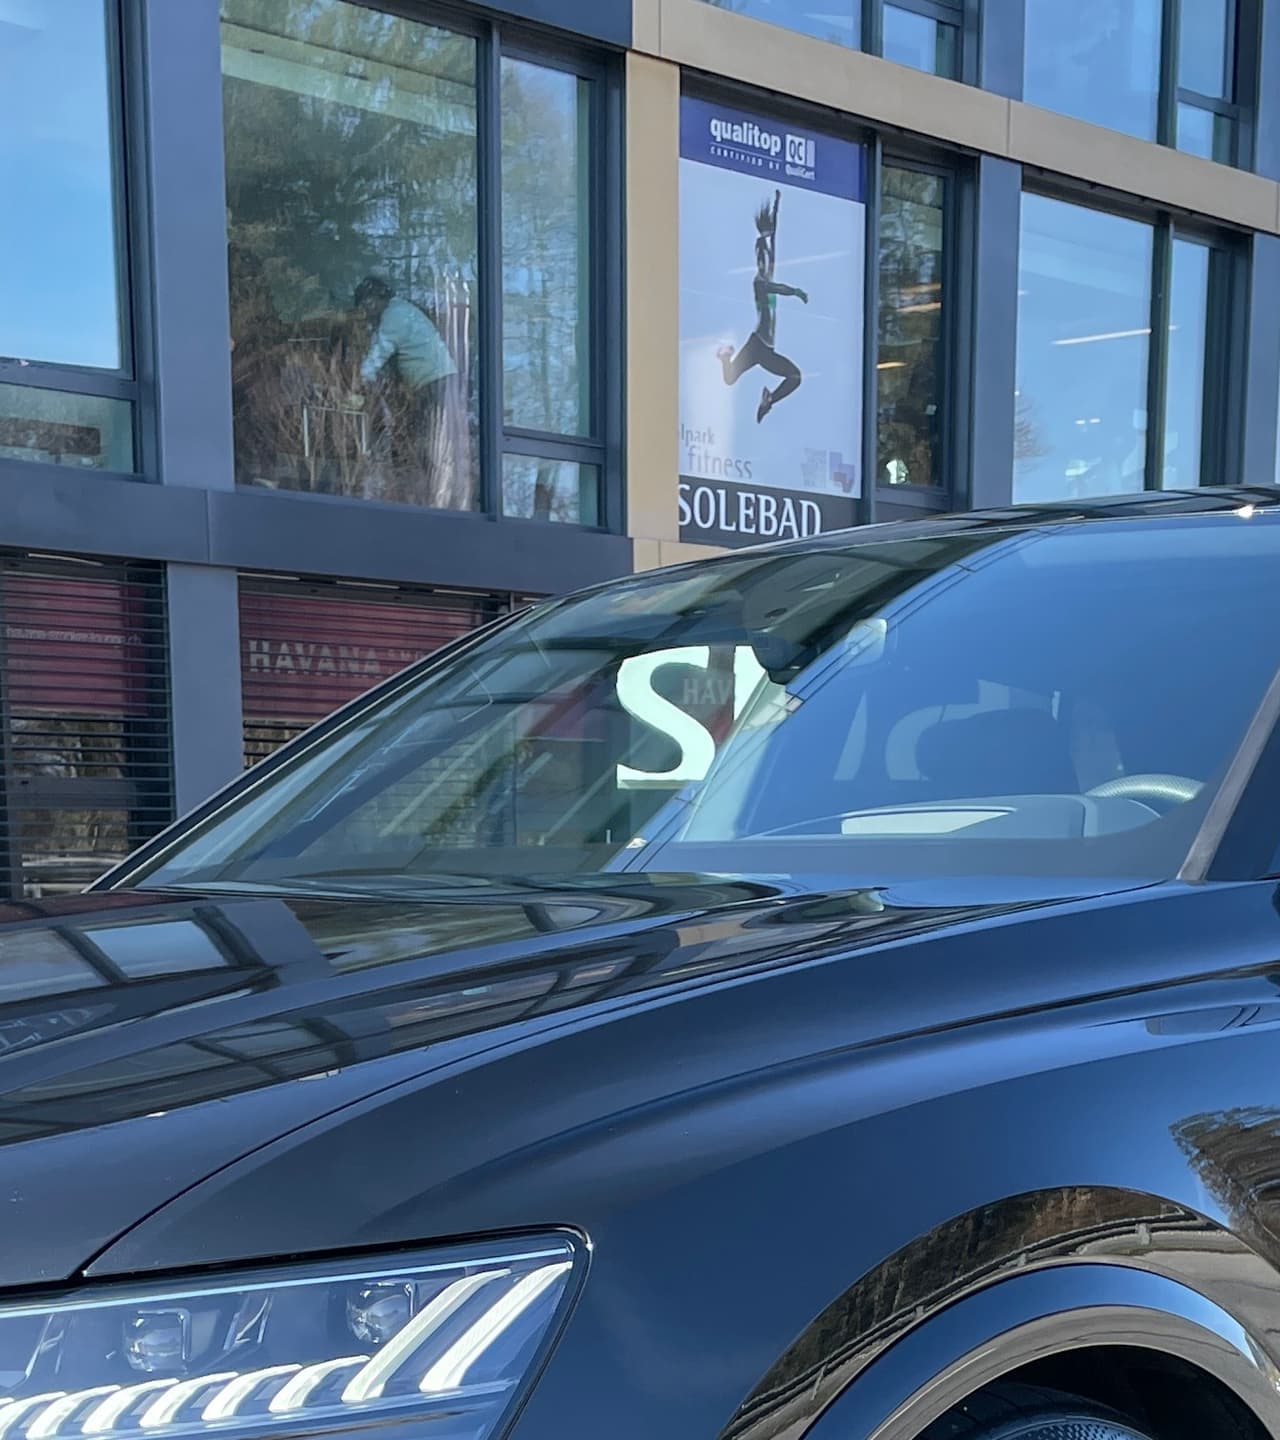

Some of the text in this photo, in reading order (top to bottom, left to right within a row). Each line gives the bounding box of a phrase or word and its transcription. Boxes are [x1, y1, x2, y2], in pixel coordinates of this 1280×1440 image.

[710, 118, 781, 156] qualitop
[688, 446, 753, 480] fitness
[678, 484, 822, 539] SOLEBAD
[248, 639, 384, 678] HAVANA
